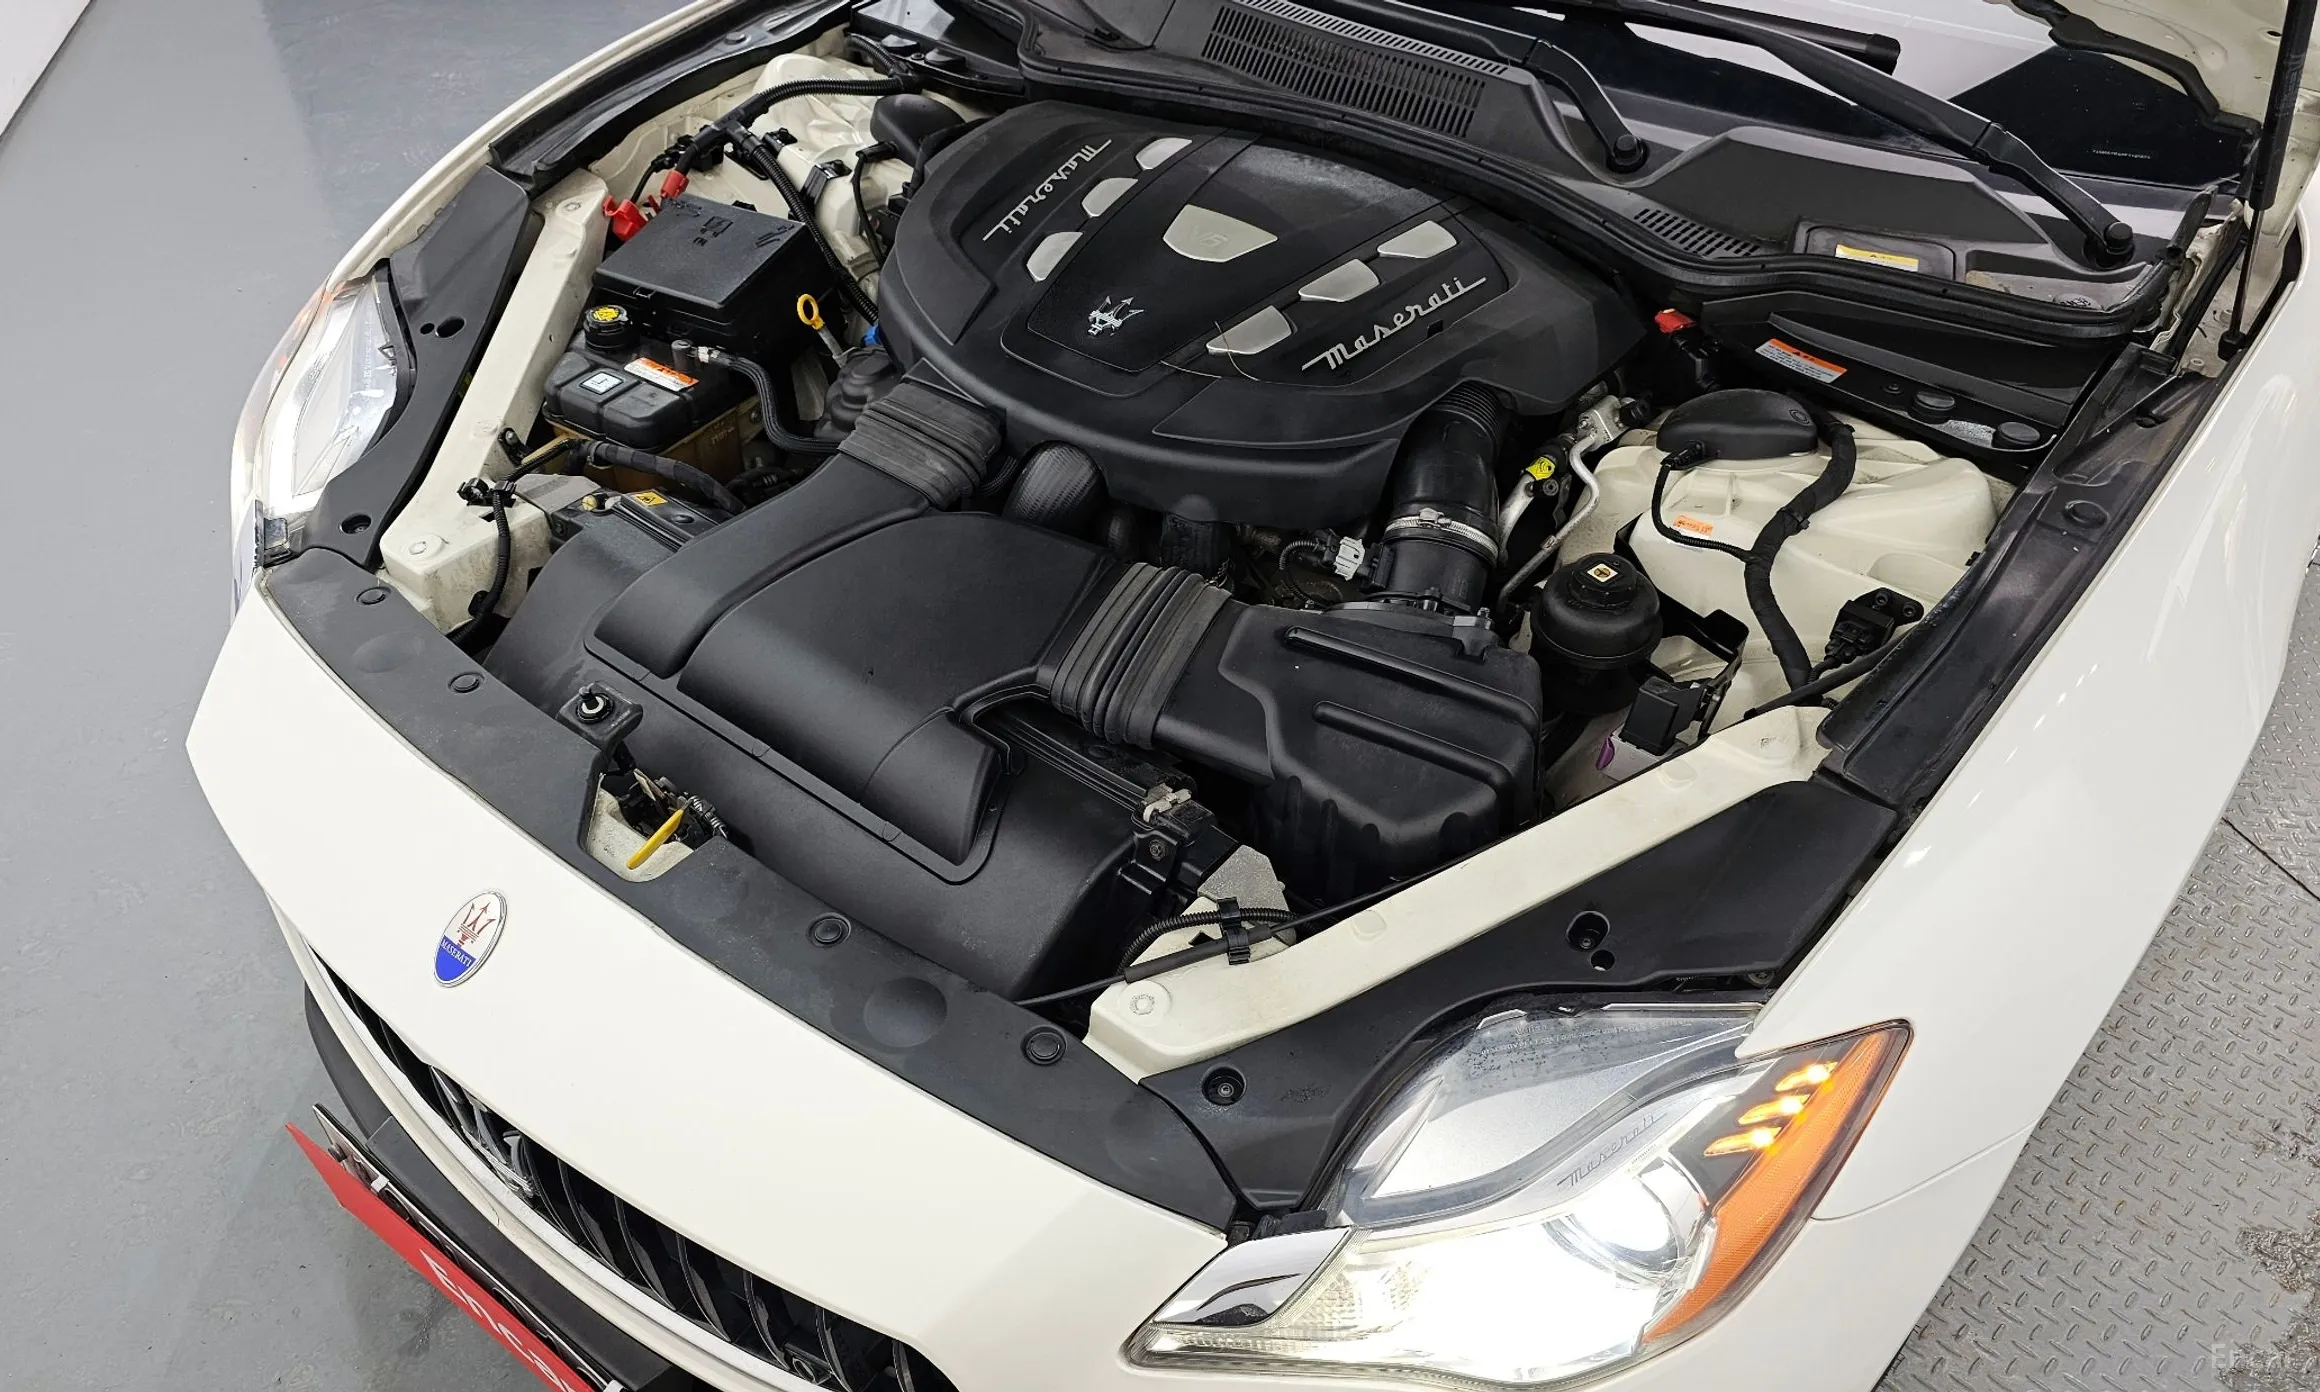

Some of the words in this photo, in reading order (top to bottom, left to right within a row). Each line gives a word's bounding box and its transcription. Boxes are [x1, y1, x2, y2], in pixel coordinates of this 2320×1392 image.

[982, 139, 1112, 241] Maserati
[1301, 276, 1487, 371] Maserati
[441, 938, 473, 968] MASERATI
[1556, 1111, 1668, 1187] Maserati
